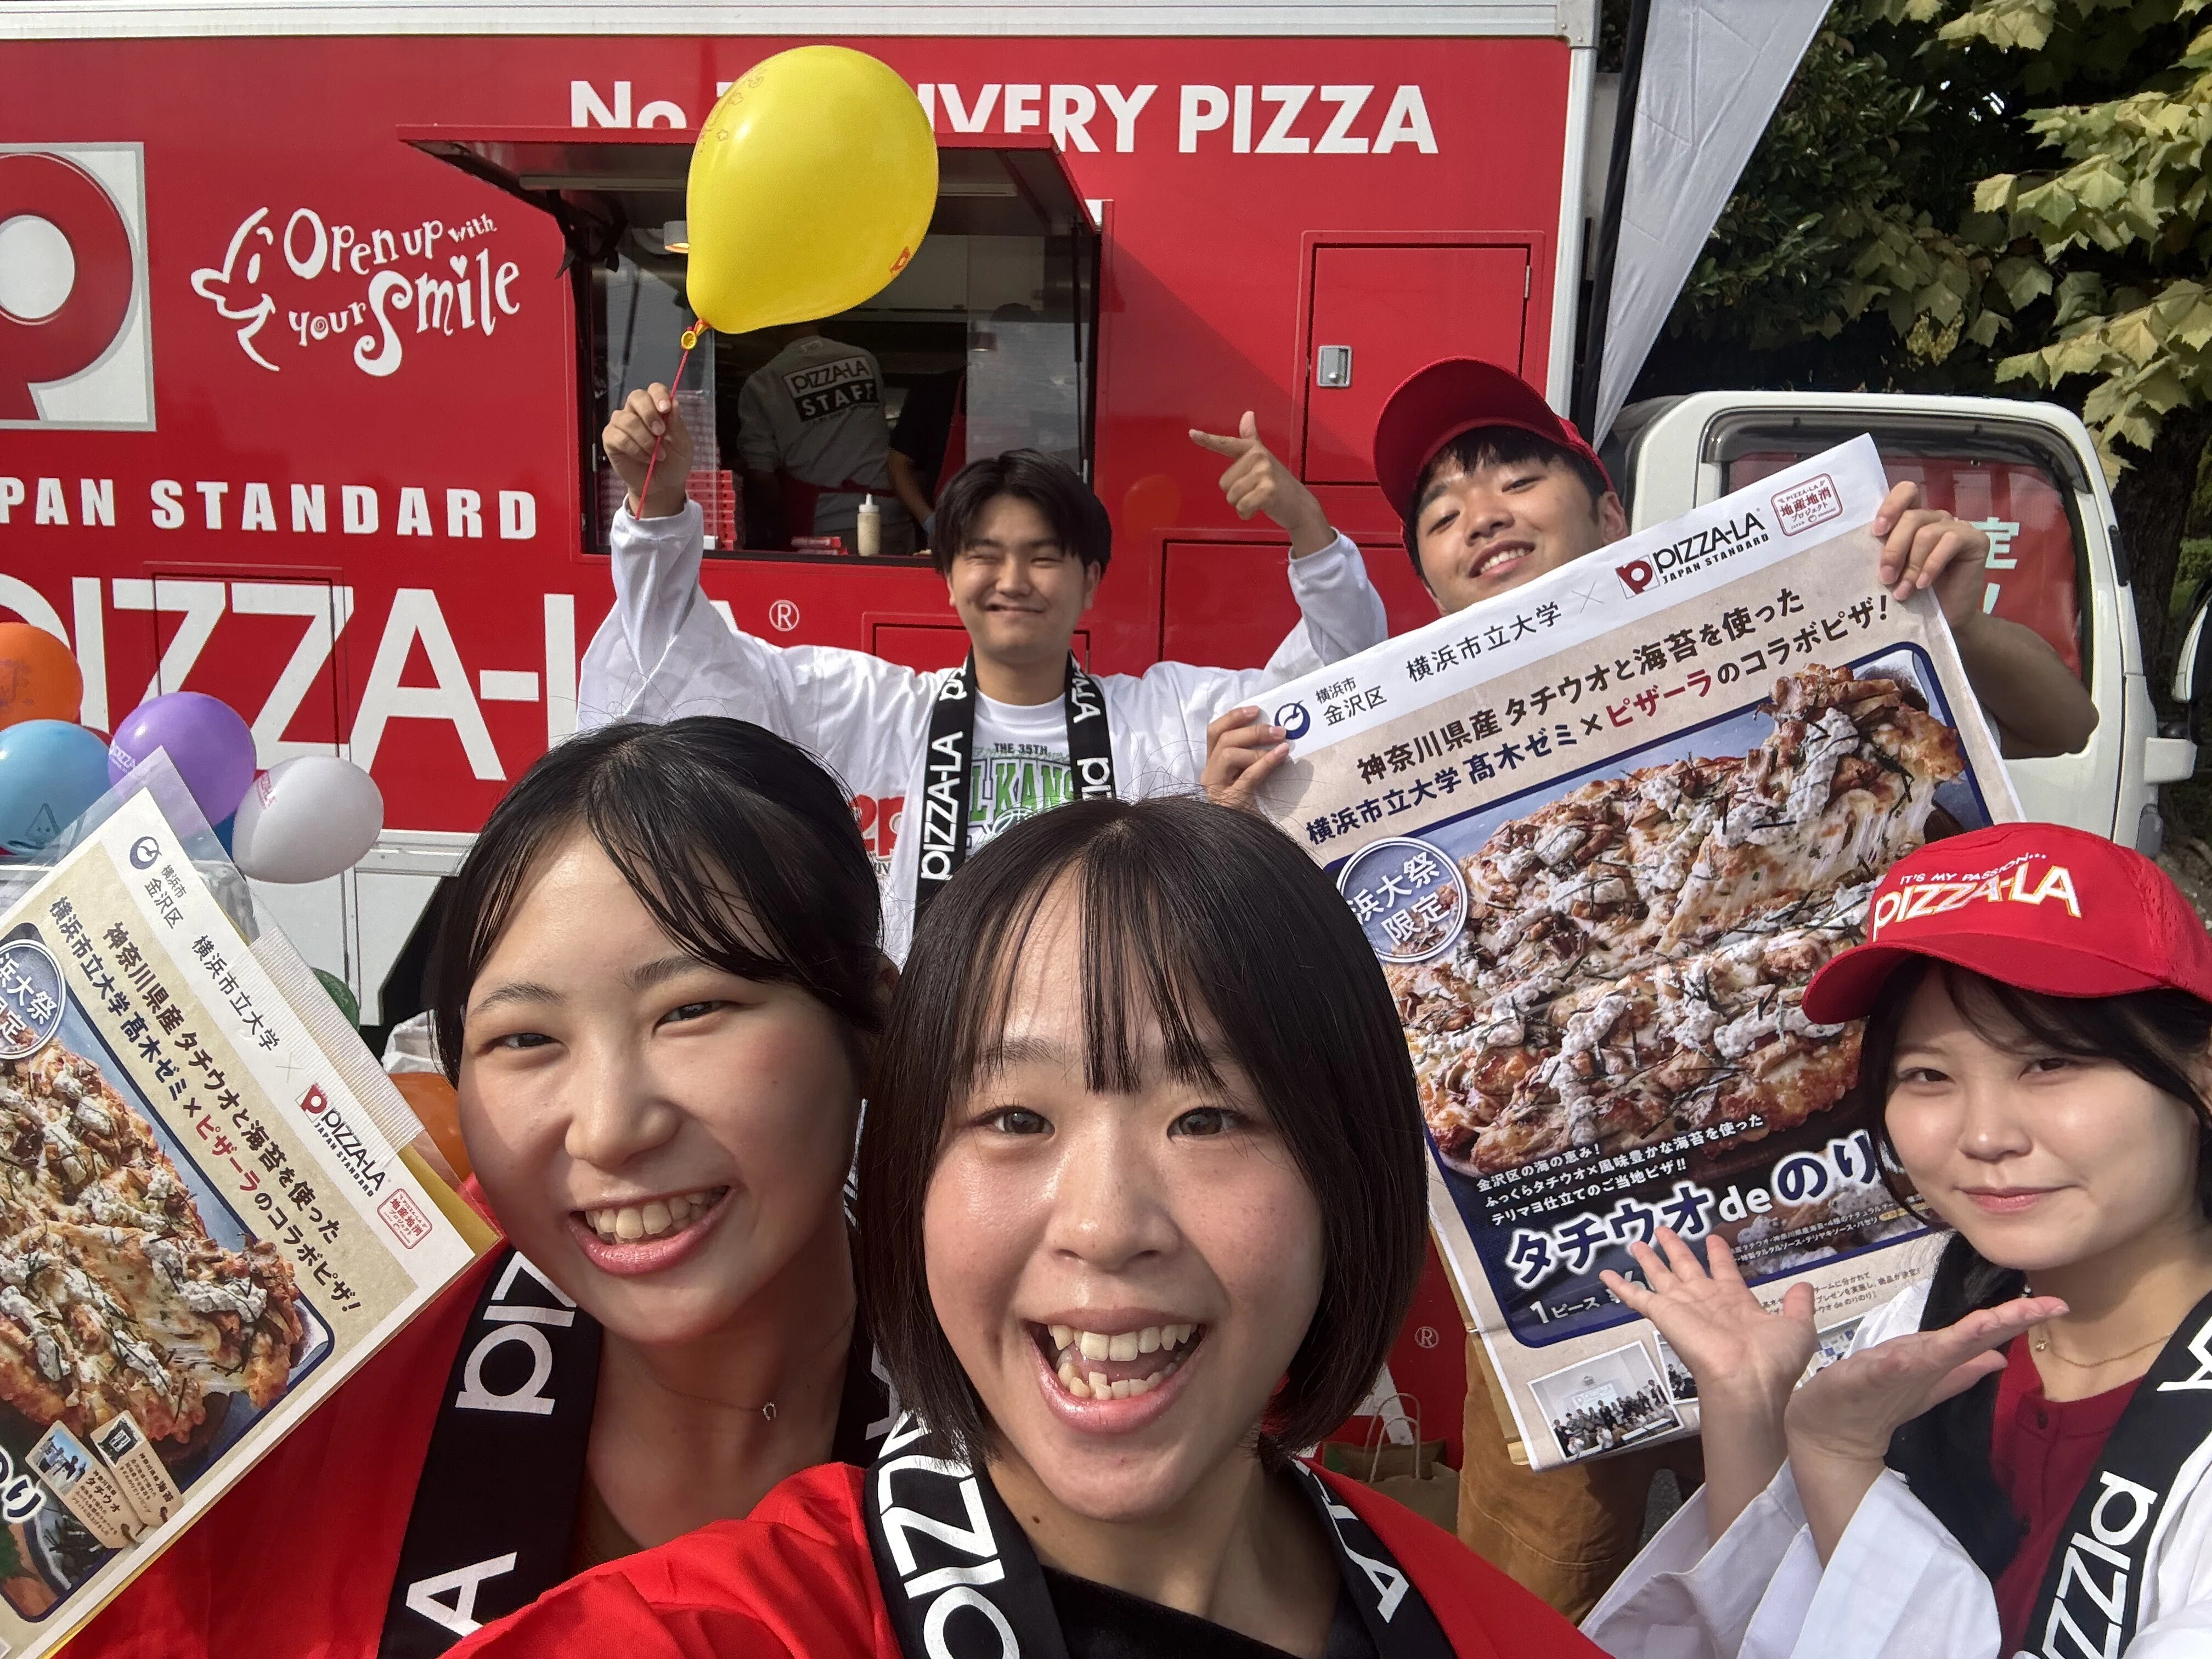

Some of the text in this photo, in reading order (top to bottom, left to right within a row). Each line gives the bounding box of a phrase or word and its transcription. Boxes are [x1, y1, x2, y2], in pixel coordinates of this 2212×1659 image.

[917, 83, 1158, 154] IVERY
[1178, 84, 1439, 154] PIZZA
[284, 208, 498, 279] Open up with
[289, 248, 521, 376] your Smile
[792, 359, 871, 393] PIZZA-LA
[801, 382, 874, 417] STAFF
[151, 478, 537, 540] STANDARD
[1780, 487, 1831, 517] 地産地消
[1653, 511, 1765, 574] PIZZA-LA
[1662, 533, 1770, 584] JAPAN STANDARD
[1406, 601, 1562, 683] 横浜市立大学
[1315, 675, 1357, 704] 横浜市
[1323, 685, 1387, 726] 金沢区
[994, 742, 1014, 753] THE
[1018, 743, 1048, 755] 35TH
[920, 730, 964, 882] PIZZA-LA
[145, 877, 184, 930] 金沢区
[161, 862, 188, 899] 横浜市
[1872, 865, 2083, 942] PIZZA-LA
[1900, 871, 1926, 885] IT'S
[1931, 871, 1958, 883] MY
[1381, 891, 1450, 946] 限定
[191, 934, 281, 1052] 横浜市立大学
[314, 1121, 375, 1197] JAPAN STANDARD
[321, 1108, 388, 1192] PIZZA-LA
[390, 1198, 424, 1237] 地産地消
[86, 1477, 120, 1512] タチウオ
